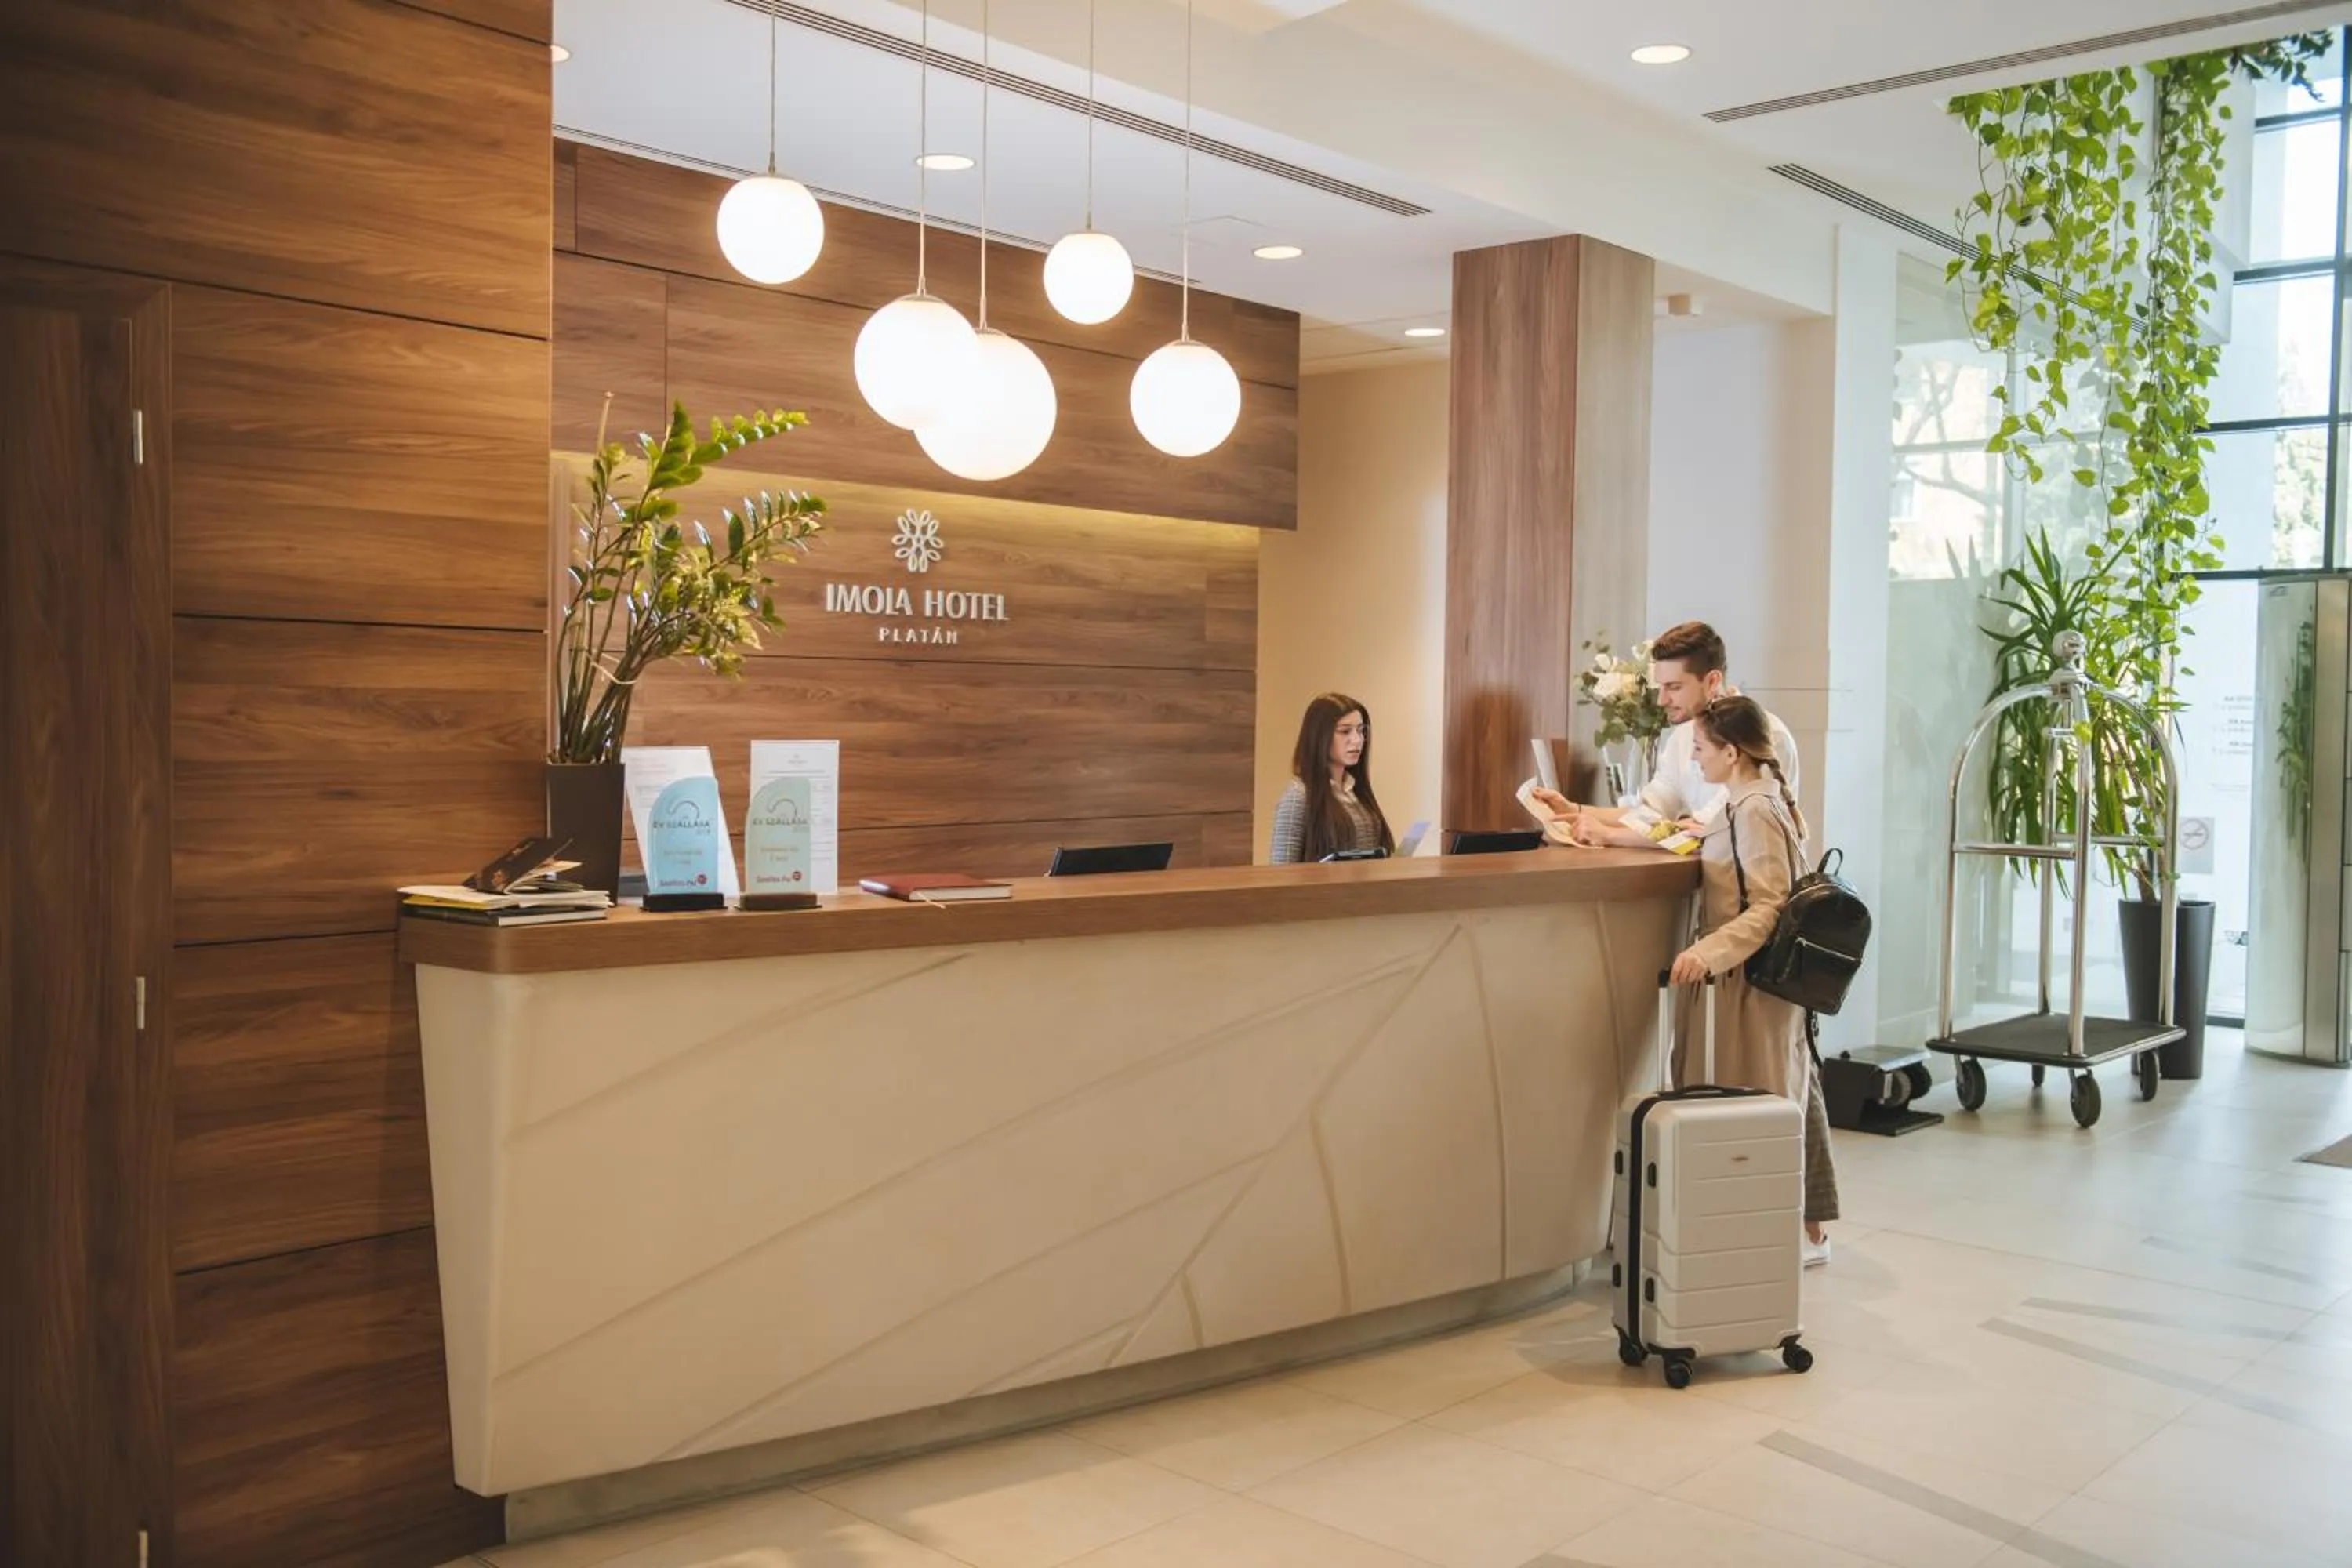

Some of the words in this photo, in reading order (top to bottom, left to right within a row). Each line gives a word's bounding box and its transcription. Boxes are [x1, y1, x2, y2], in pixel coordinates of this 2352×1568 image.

[826, 583, 913, 615] IMOLA
[924, 590, 1010, 620] HOTEL
[878, 626, 958, 644] PLATÁN
